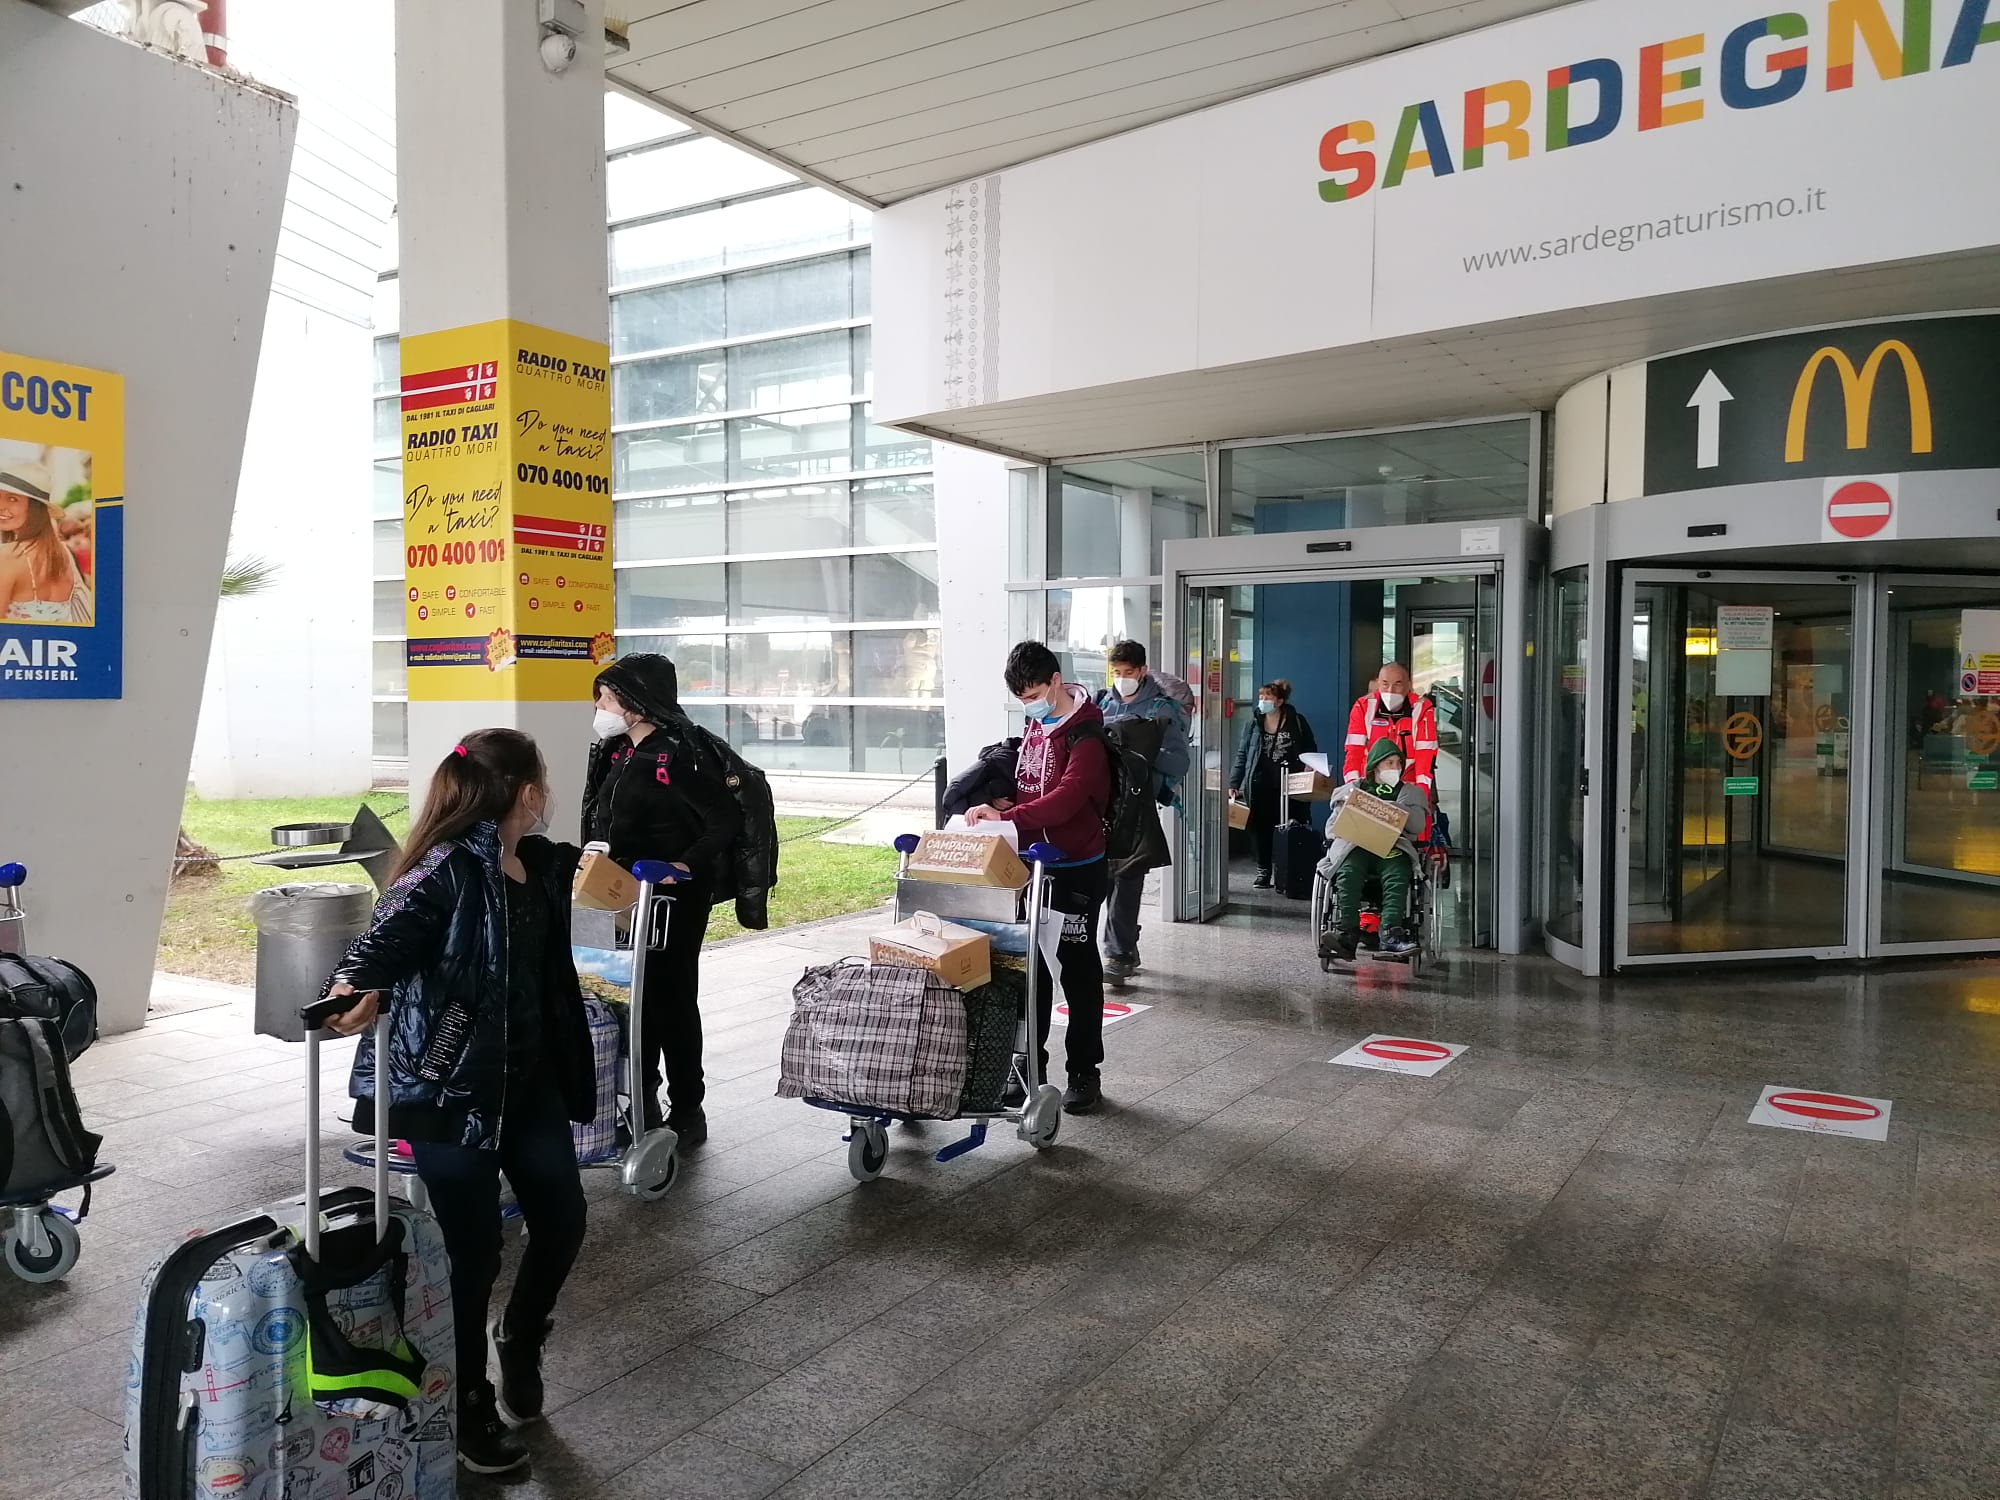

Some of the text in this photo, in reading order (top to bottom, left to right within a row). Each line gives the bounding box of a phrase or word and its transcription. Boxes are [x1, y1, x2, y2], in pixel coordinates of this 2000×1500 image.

[1462, 186, 1828, 273] www.sardegnaturismo.it
[516, 364, 605, 392] QUATTRO MORI
[517, 348, 606, 382] RADIO TAXI
[2, 370, 92, 421] COST
[406, 403, 495, 422] DAL 1981 IL TAXI DI CAGLIARI
[407, 422, 498, 449] RADIO TAXI
[516, 410, 607, 445] Do you need
[406, 440, 498, 462] QUATTRO MORI
[556, 436, 604, 462] taxi?
[518, 462, 608, 494] 070 400 101
[406, 481, 502, 522] Do you need
[446, 506, 500, 534] taxi?
[407, 538, 505, 568] 070 400 101
[578, 553, 603, 561] CAGLIARI
[533, 577, 550, 586] SAFE
[422, 590, 440, 600] SAFE
[542, 600, 600, 612] SIMPLE FAST
[432, 606, 496, 617] SIMPLE FAST
[0, 639, 78, 667] AIR
[520, 638, 588, 648] www.cagliaritaxi.com
[5, 669, 78, 680] PENSIERI.
[926, 839, 984, 853] CAMPAGNA
[930, 850, 970, 862] AMICA
